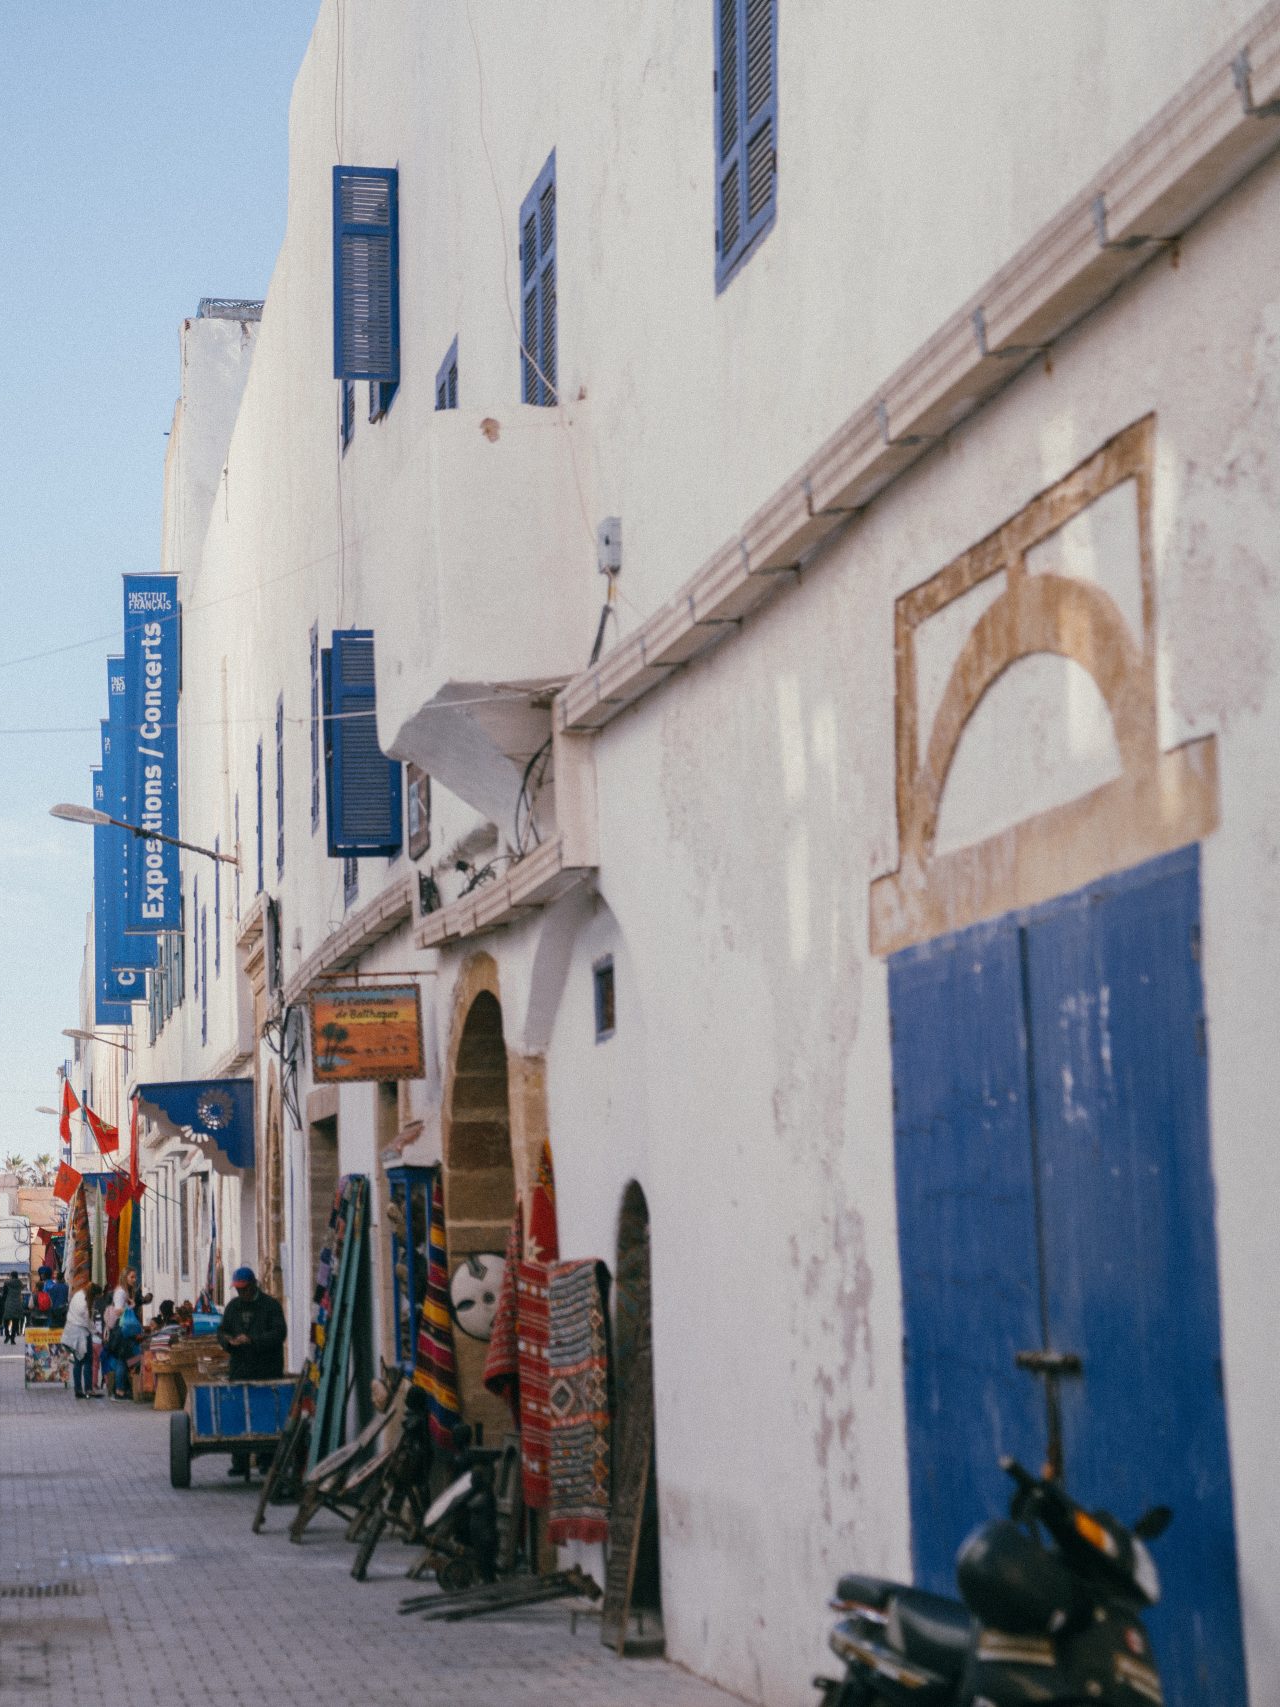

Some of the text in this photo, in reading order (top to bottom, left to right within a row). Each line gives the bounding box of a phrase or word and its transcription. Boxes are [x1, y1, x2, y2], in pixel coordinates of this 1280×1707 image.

[128, 592, 168, 602] INSTITUT
[128, 600, 172, 612] FRANÇAIS
[139, 621, 163, 741] Concerts
[142, 762, 166, 920] Expostions
